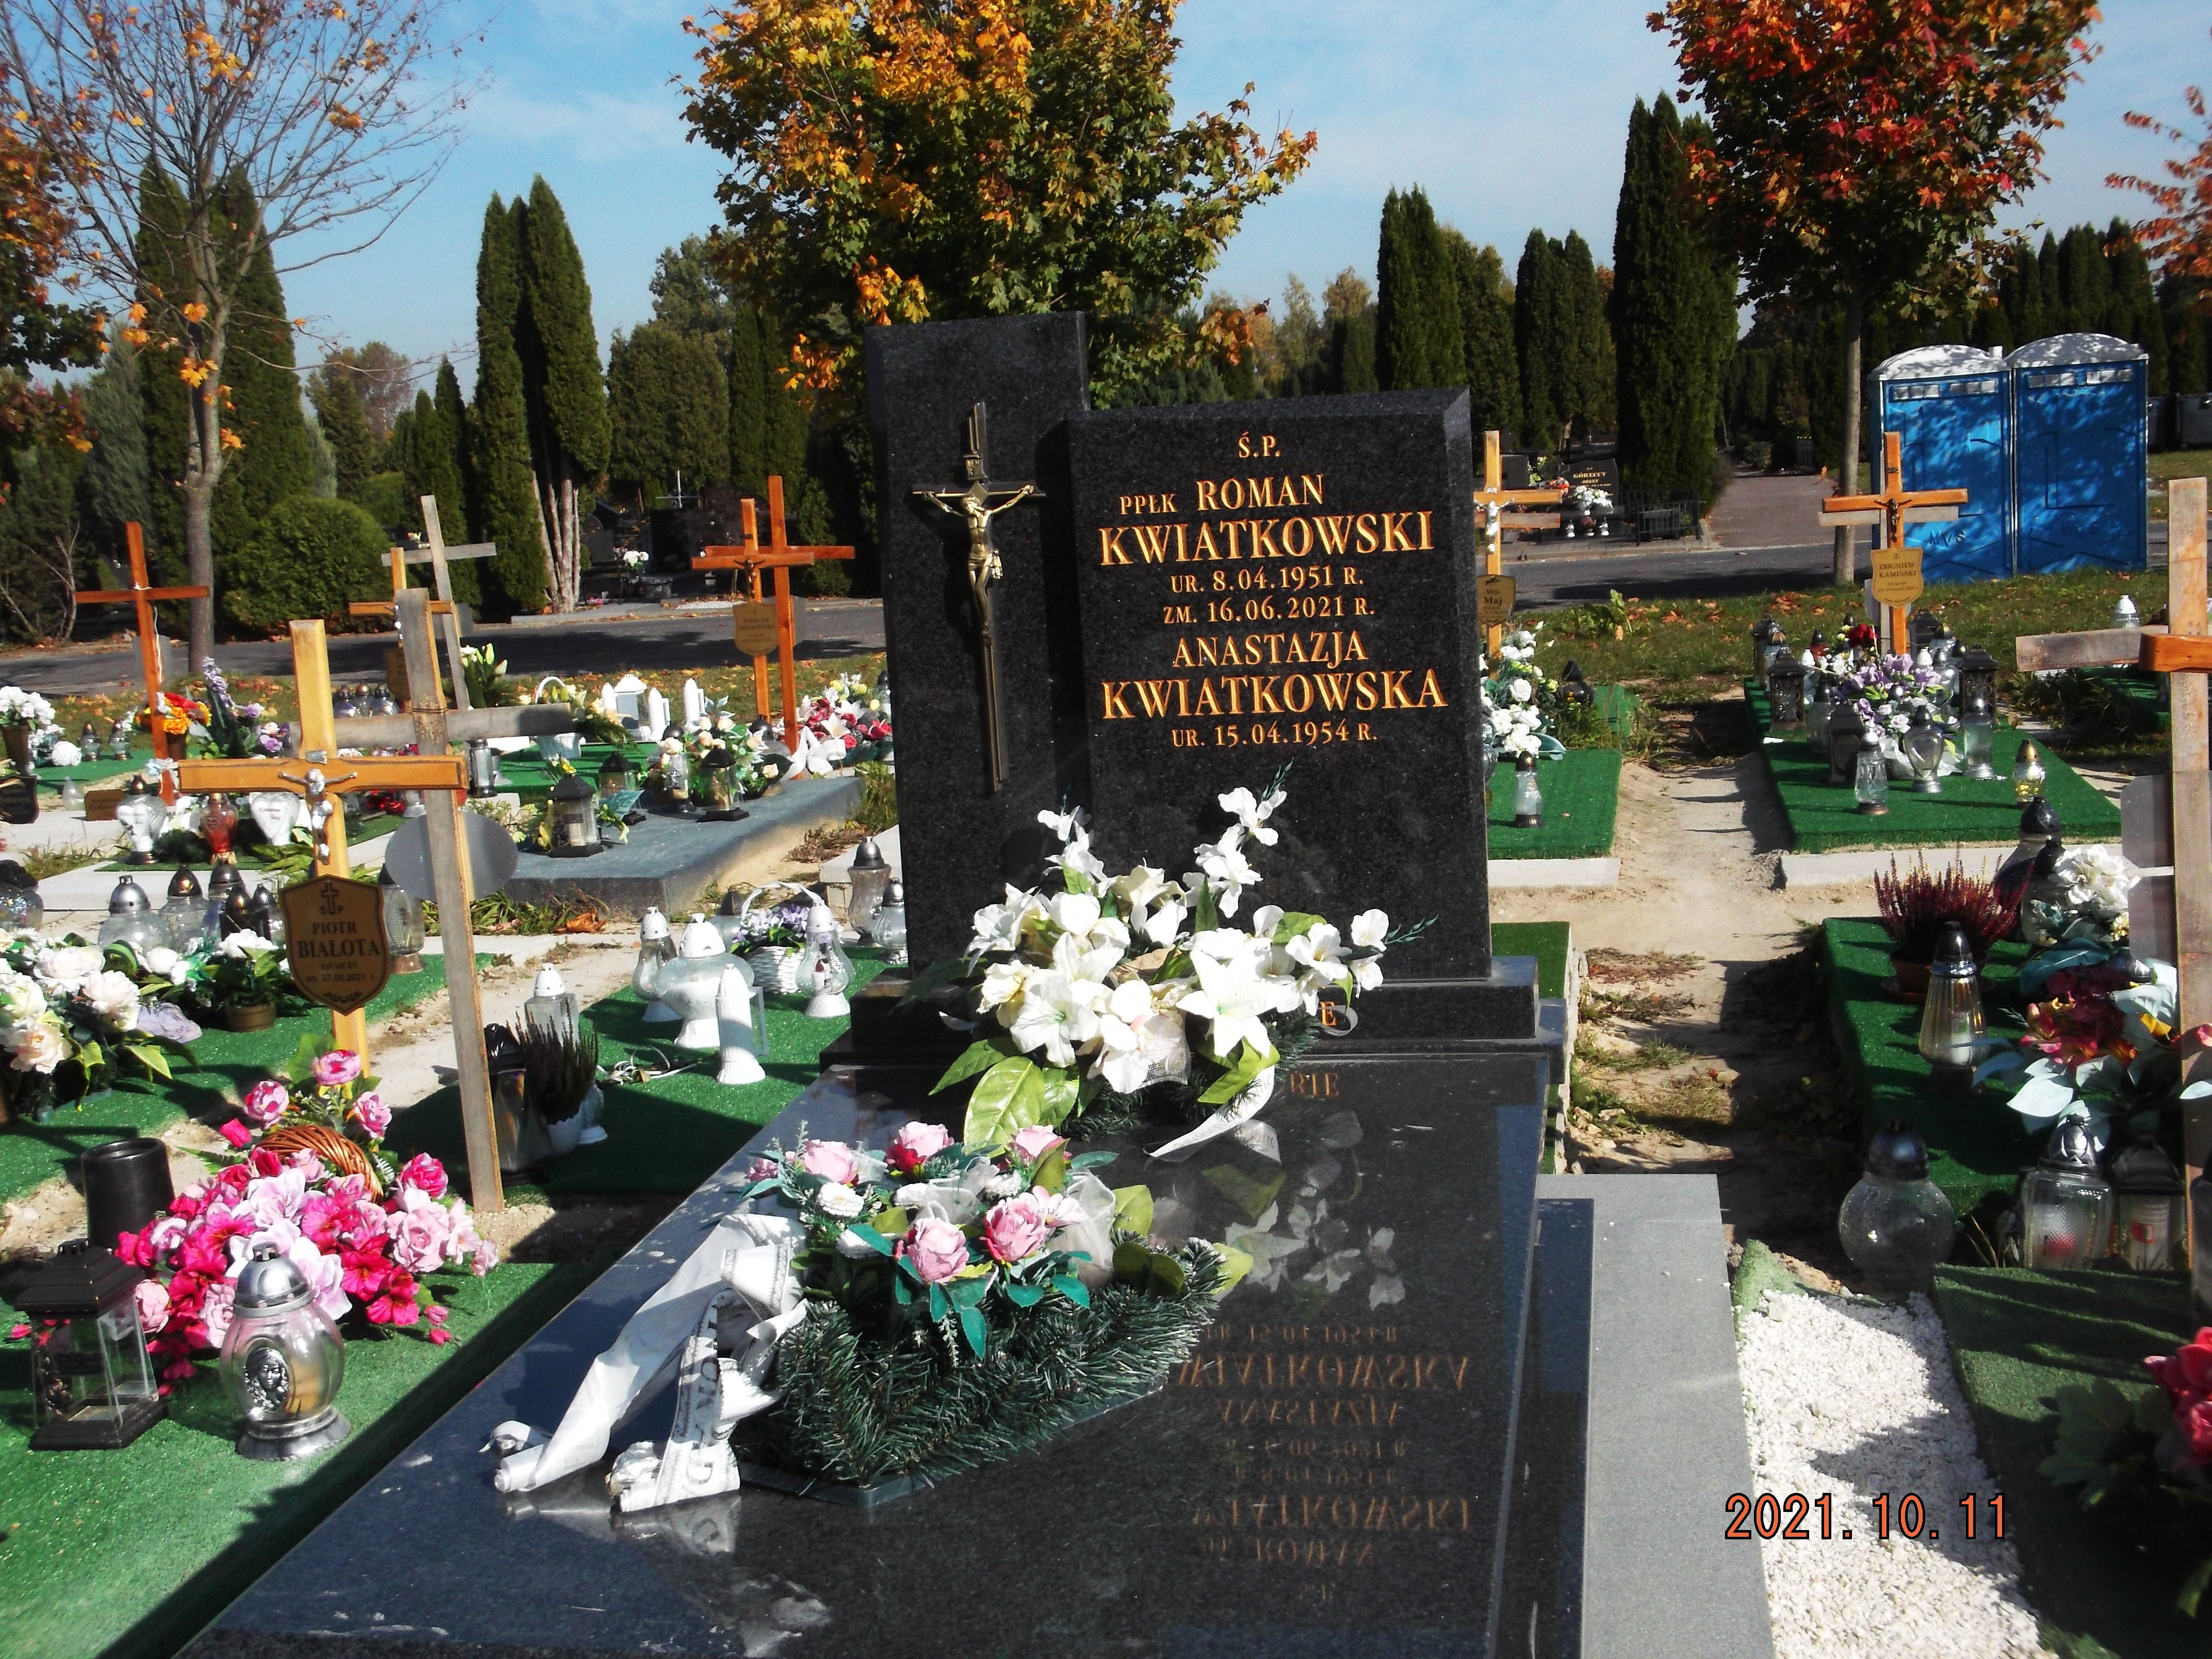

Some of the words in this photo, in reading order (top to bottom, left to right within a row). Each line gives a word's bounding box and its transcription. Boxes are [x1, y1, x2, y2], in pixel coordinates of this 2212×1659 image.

[1238, 431, 1281, 458] Ś.P.
[1120, 493, 1177, 515] PPŁK
[1196, 474, 1324, 511] ROMAN
[1099, 511, 1434, 566] KWIATKOWSKI
[1170, 574, 1205, 592] UR.
[1212, 564, 1333, 591] 8.04.1951
[1343, 566, 1364, 585] R.
[1879, 570, 1916, 578] KAMIŃSKI
[1164, 605, 1198, 624] ZM.
[1208, 595, 1344, 622] 16.06.2021
[1355, 596, 1375, 615] R.
[1484, 596, 1502, 606] Maj
[1173, 630, 1369, 669] ANASTAZJA
[1102, 669, 1448, 719] KWIATKOWSKA
[1172, 728, 1205, 747] UR.
[1215, 719, 1349, 747] 15.04.1954
[1358, 722, 1377, 741] R.
[312, 921, 357, 934] PIOTR
